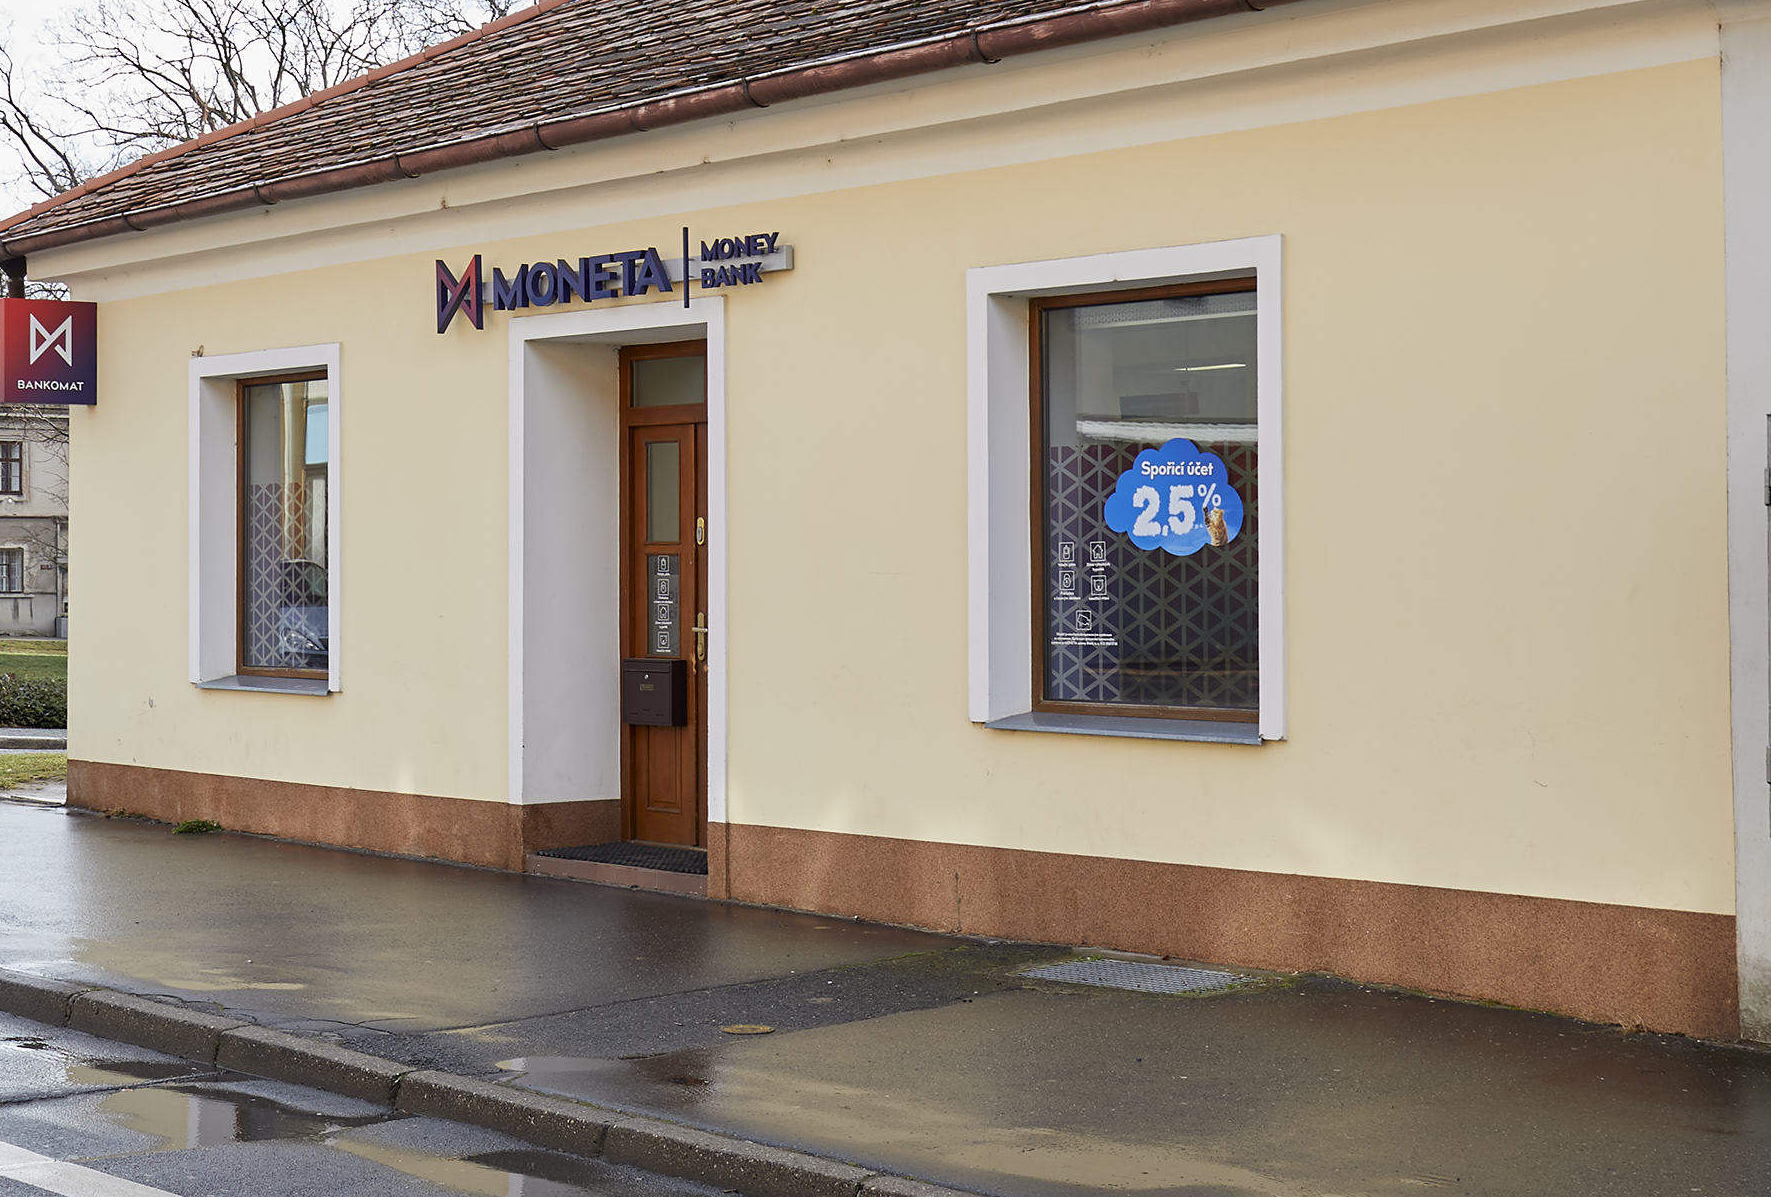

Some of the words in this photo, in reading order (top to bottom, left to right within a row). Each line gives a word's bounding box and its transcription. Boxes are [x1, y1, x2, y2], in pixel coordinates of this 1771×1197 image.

[701, 232, 779, 261] MONEY
[493, 247, 673, 311] MONETA
[701, 262, 763, 289] BANK
[17, 380, 84, 391] BANKOMAT
[1141, 461, 1185, 480] Spořicí
[1188, 462, 1214, 476] účet
